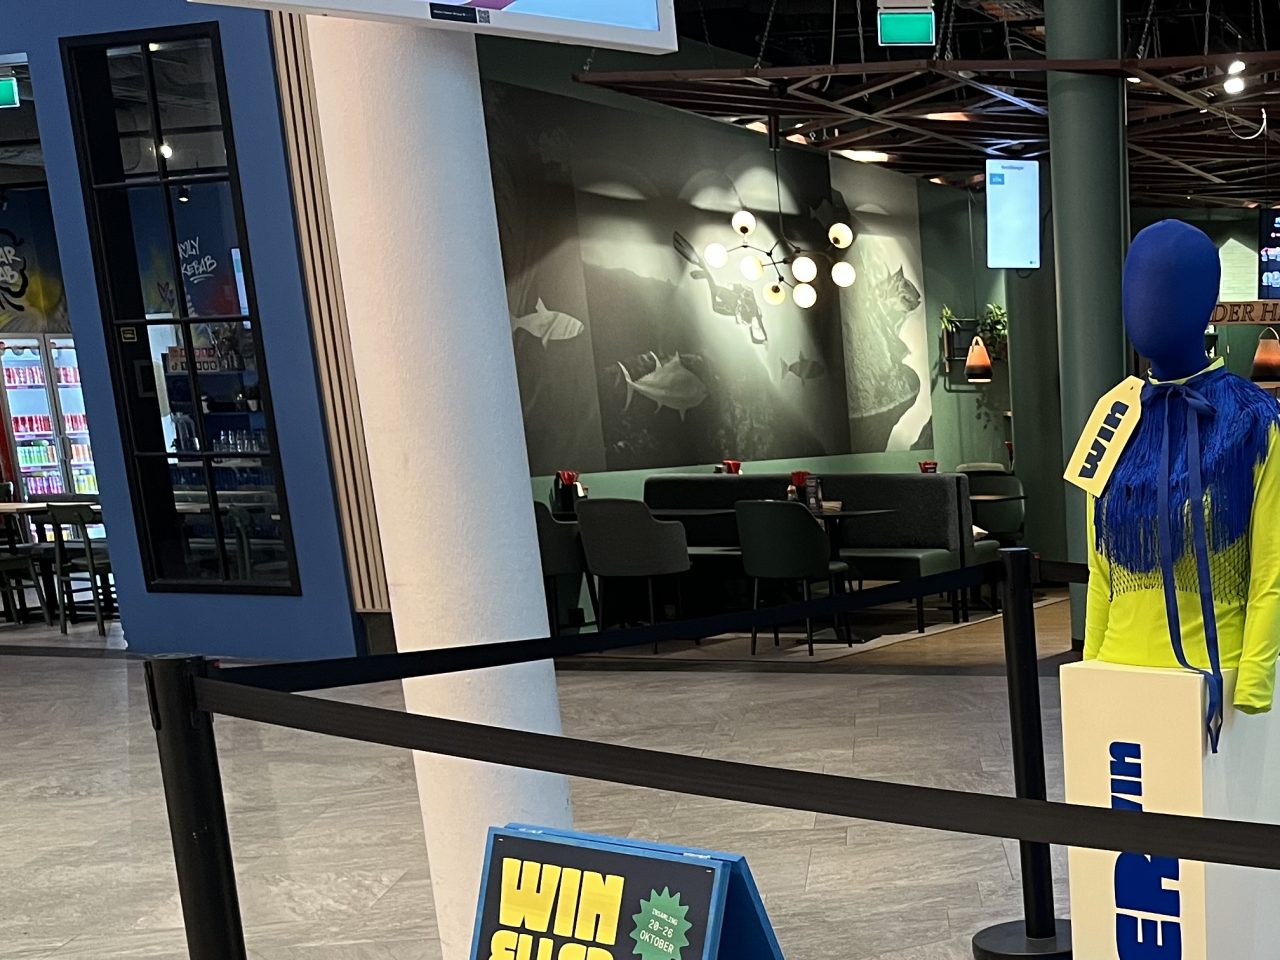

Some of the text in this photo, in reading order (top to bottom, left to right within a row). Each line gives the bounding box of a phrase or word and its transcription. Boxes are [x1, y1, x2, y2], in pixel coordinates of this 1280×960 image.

[181, 255, 217, 275] KEBAB
[499, 857, 625, 946] WIN
[648, 919, 674, 938] 20-26
[640, 930, 675, 954] OKTOBER
